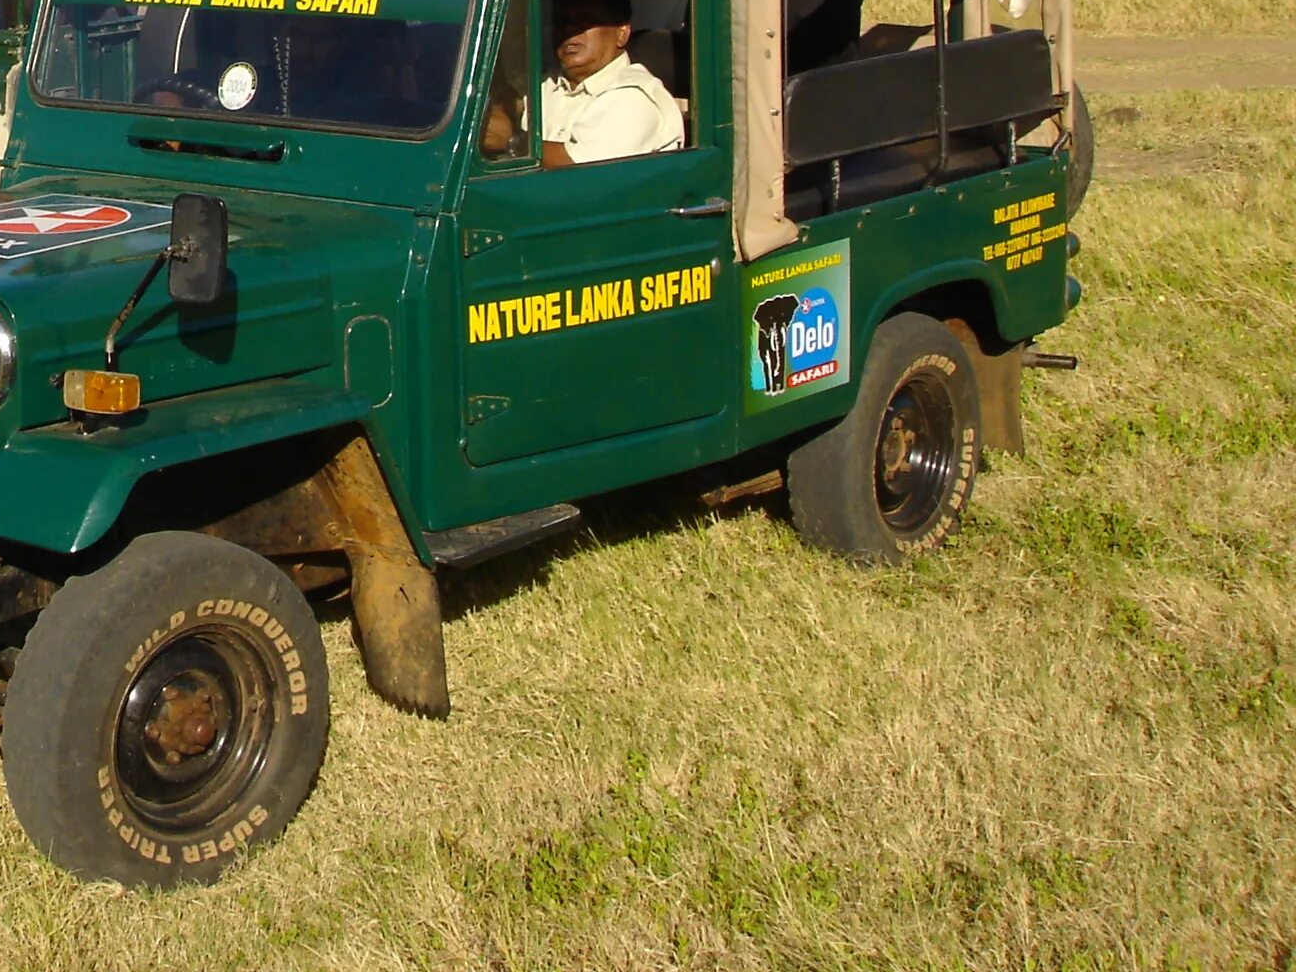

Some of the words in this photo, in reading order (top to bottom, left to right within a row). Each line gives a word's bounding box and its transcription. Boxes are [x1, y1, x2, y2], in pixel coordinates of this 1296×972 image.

[751, 268, 785, 288] NATURE
[785, 260, 814, 279] LANKA
[813, 253, 842, 271] SAFARI
[468, 292, 561, 343] NATURE
[565, 279, 635, 327] LANKA
[640, 265, 711, 312] SAFARI
[791, 315, 834, 358] Delo
[791, 362, 835, 386] SAFARI
[125, 611, 186, 673] WILD
[197, 599, 307, 716] CONQUEROR
[98, 765, 172, 864] TRIPPER
[182, 805, 268, 864] SUPER
